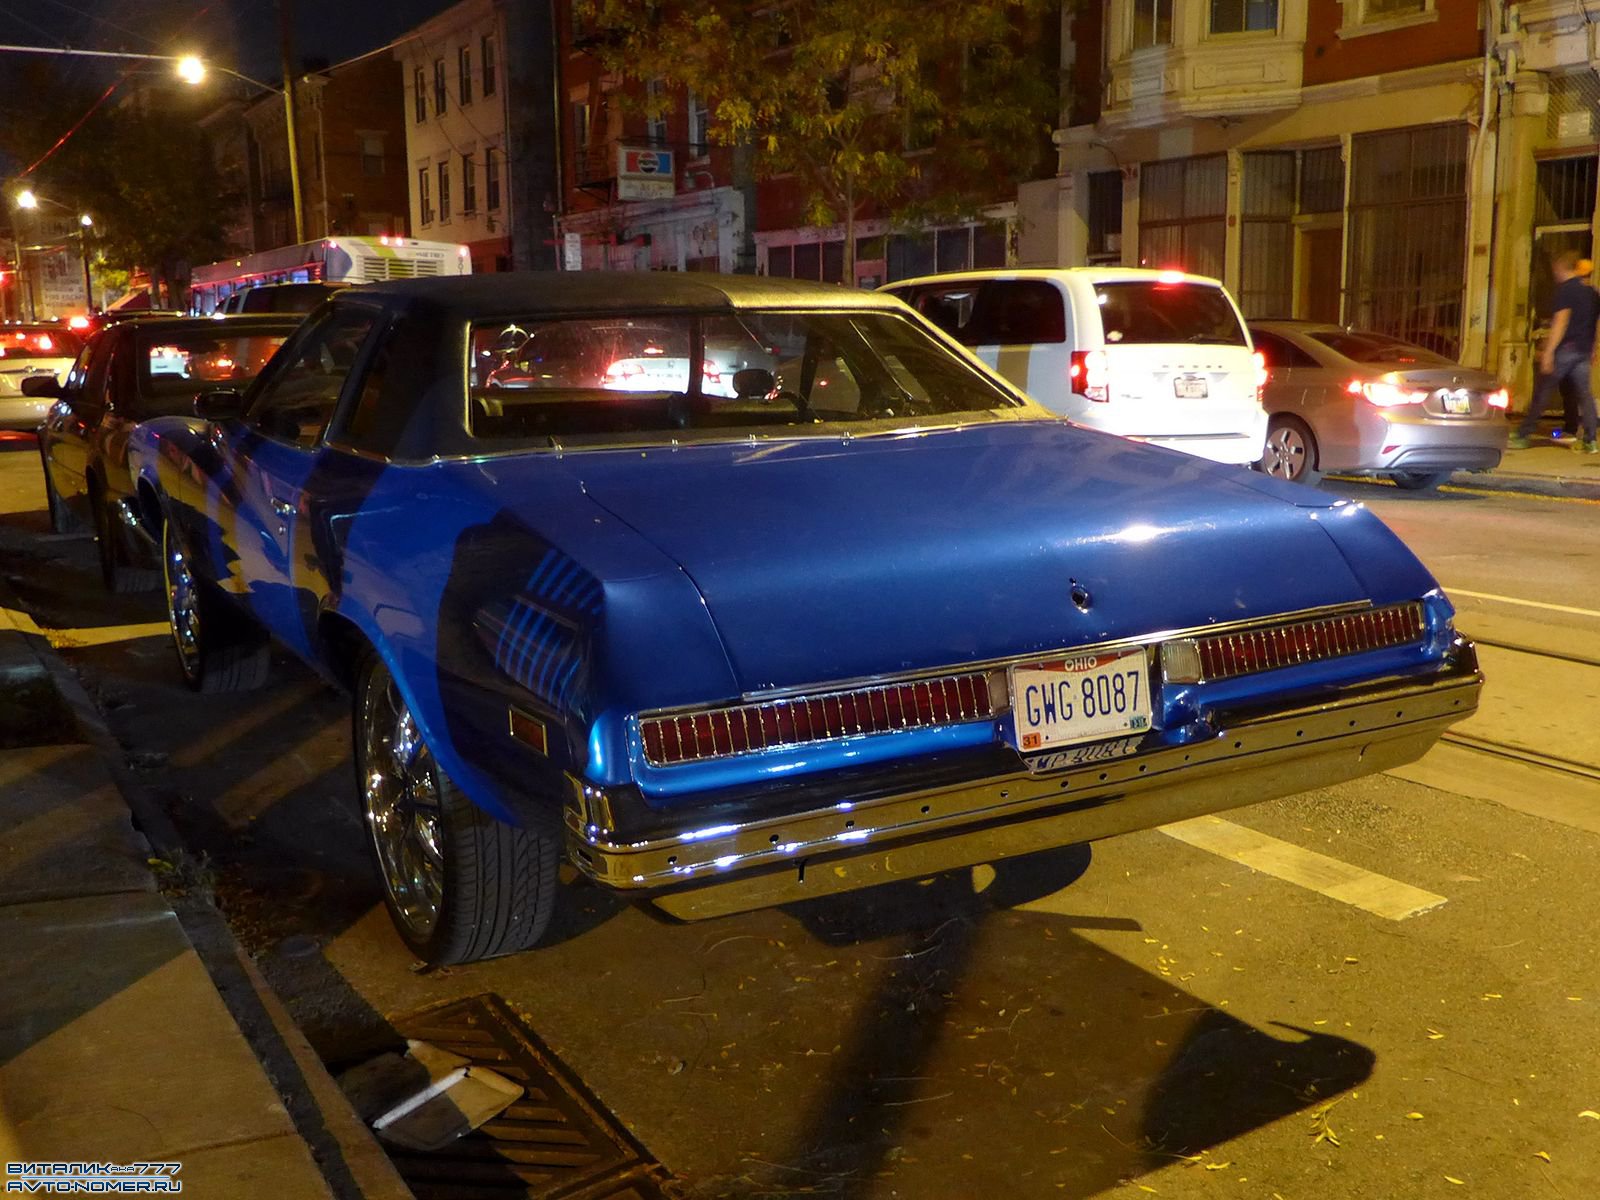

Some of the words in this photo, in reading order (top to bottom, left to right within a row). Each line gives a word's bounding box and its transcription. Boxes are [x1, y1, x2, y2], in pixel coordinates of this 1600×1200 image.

[1064, 656, 1097, 671] OHIO
[1025, 681, 1073, 727] GWG
[1081, 670, 1139, 718] 8087
[1023, 734, 1039, 747] 31
